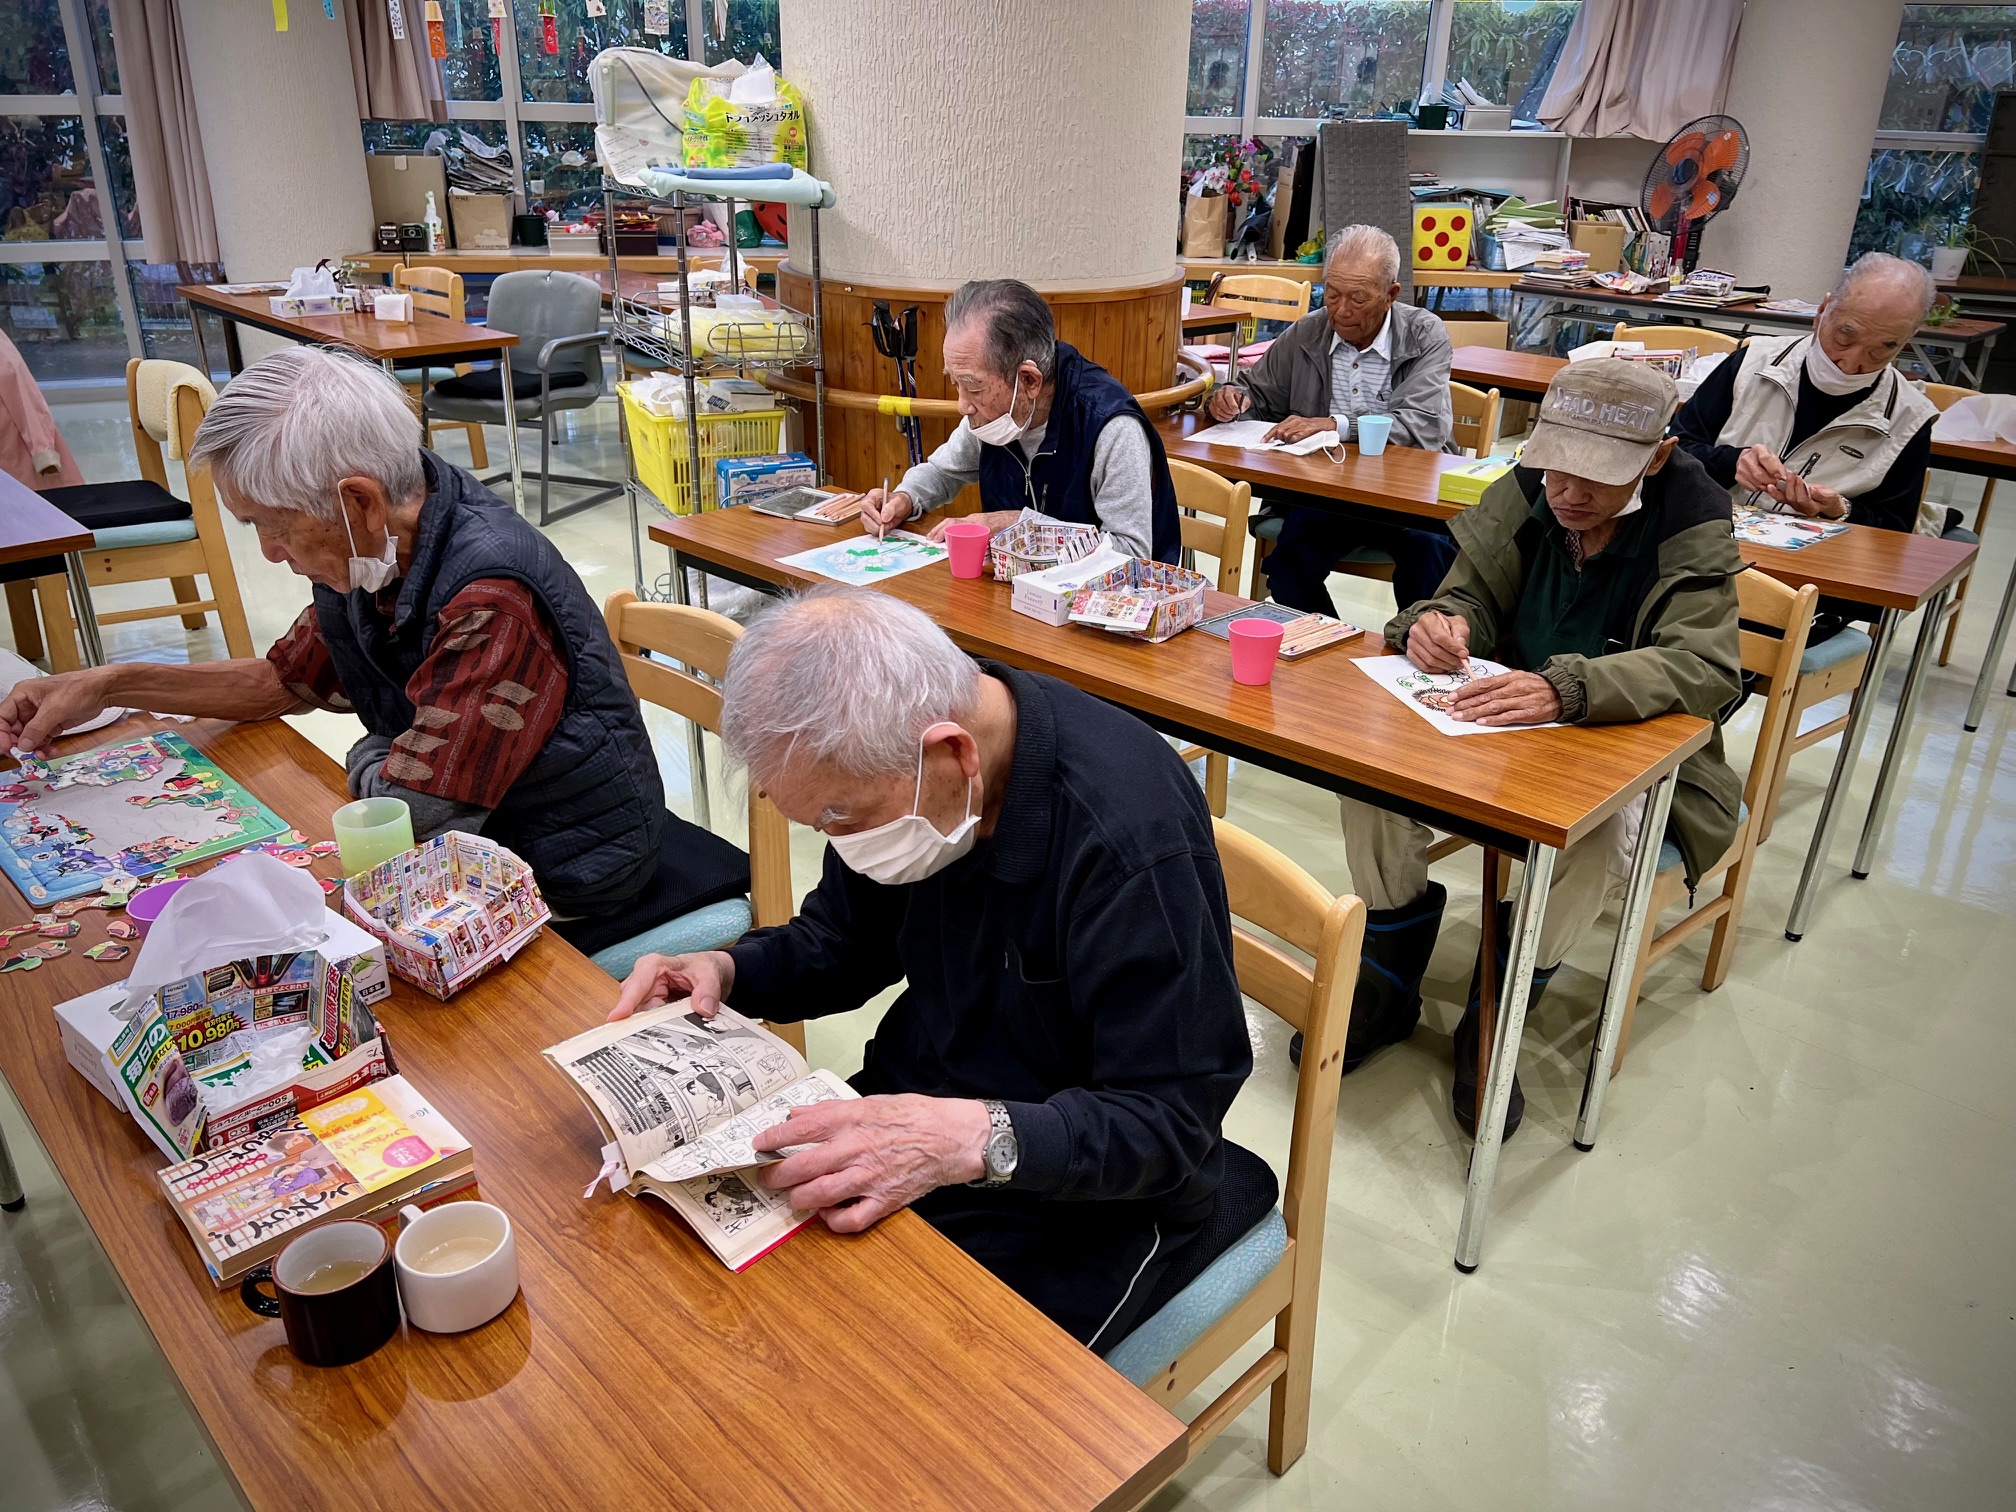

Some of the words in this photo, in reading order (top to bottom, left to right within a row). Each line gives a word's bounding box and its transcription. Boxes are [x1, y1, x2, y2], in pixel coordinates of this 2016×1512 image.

[1551, 386, 1595, 416] DEAD
[1599, 403, 1655, 432] HEAT
[126, 1022, 167, 1084] 毎日の
[178, 1018, 240, 1052] 10,980円
